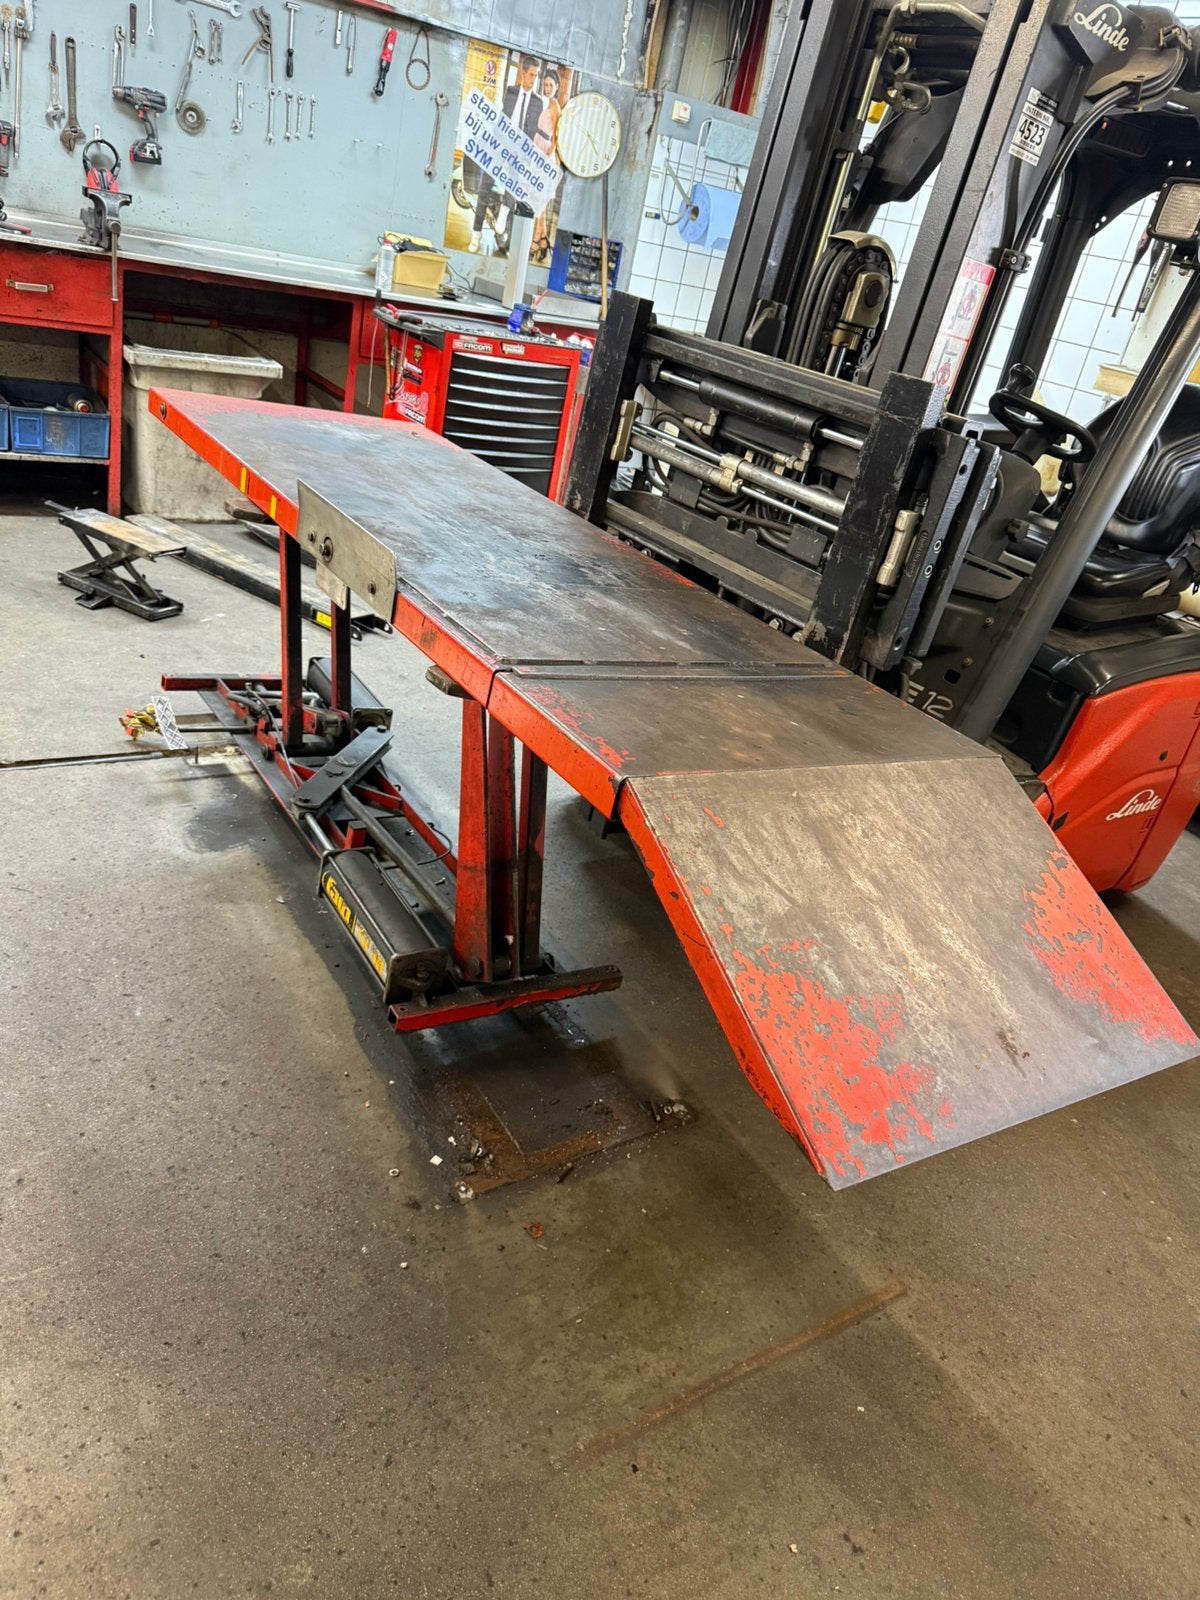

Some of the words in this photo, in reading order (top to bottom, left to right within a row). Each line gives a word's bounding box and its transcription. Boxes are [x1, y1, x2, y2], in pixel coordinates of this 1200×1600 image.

[1074, 3, 1130, 51] Linde
[465, 112, 483, 136] bij
[482, 130, 501, 151] uw
[501, 148, 544, 192] erkende
[470, 93, 497, 121] stap
[498, 116, 521, 143] hier
[521, 139, 558, 180] binnen
[1019, 118, 1046, 146] 4523
[465, 138, 493, 169] SYM
[492, 166, 528, 200] dealer
[922, 691, 954, 719] 12
[1106, 789, 1162, 821] Linde
